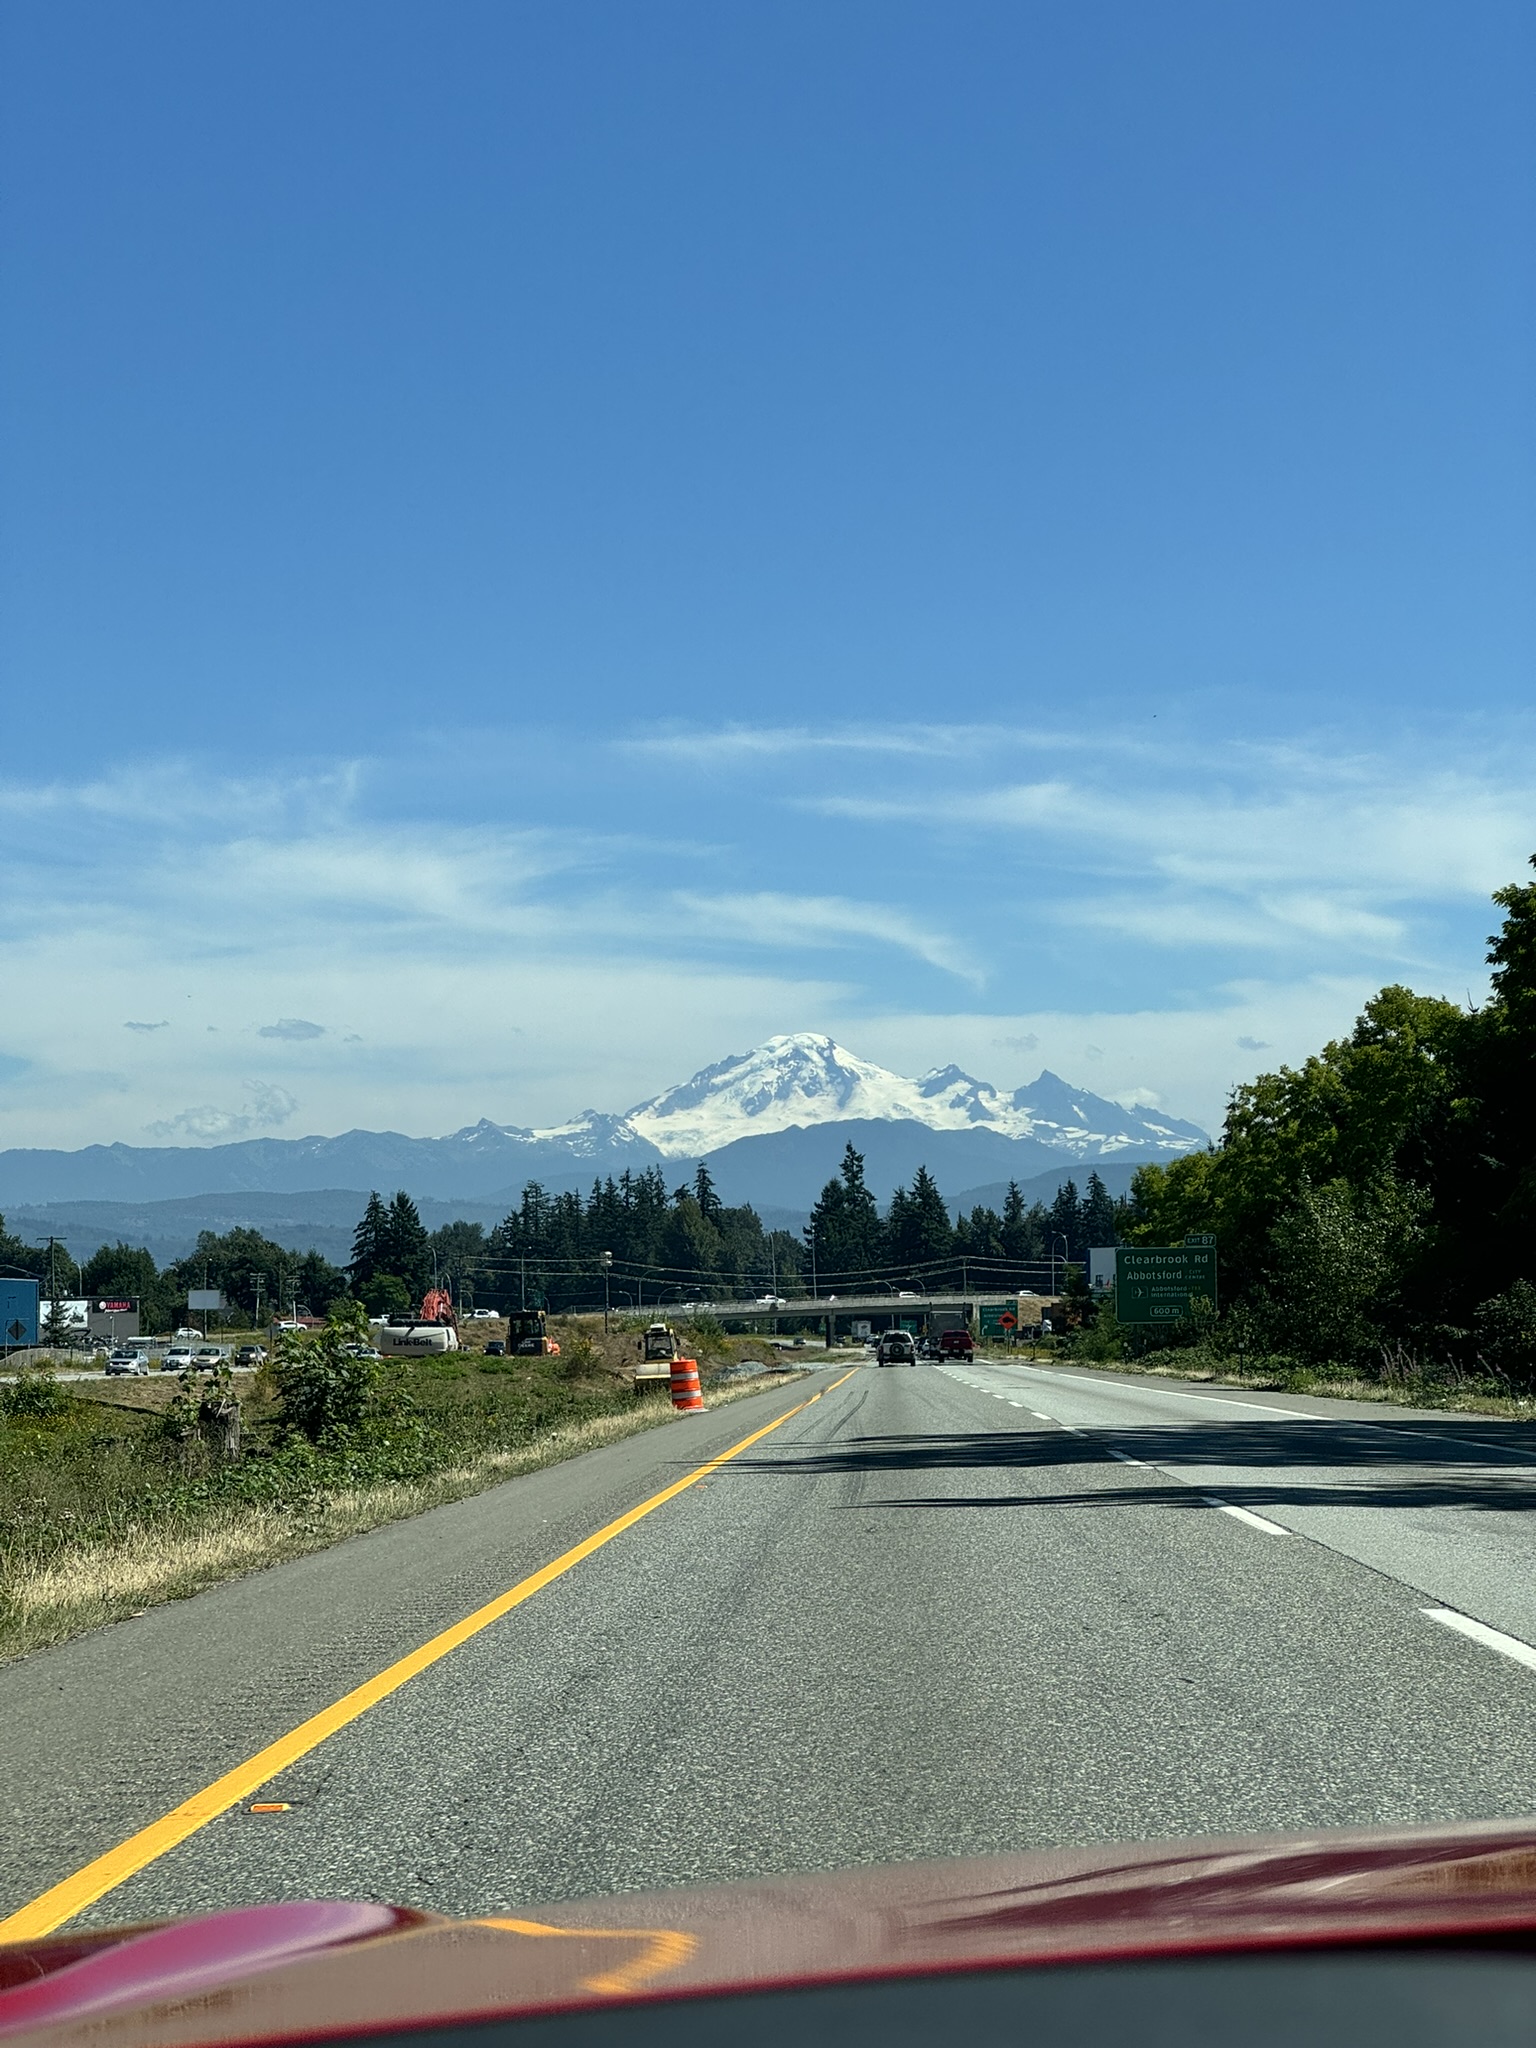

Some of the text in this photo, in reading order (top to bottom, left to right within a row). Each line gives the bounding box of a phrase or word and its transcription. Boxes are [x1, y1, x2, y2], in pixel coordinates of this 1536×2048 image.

[1201, 1236, 1214, 1245] 87
[1124, 1254, 1208, 1265] Clearbrook Rd
[1126, 1270, 1182, 1280] Abbotsford
[106, 1301, 131, 1309] YAMAHA
[1153, 1306, 1170, 1314] 600
